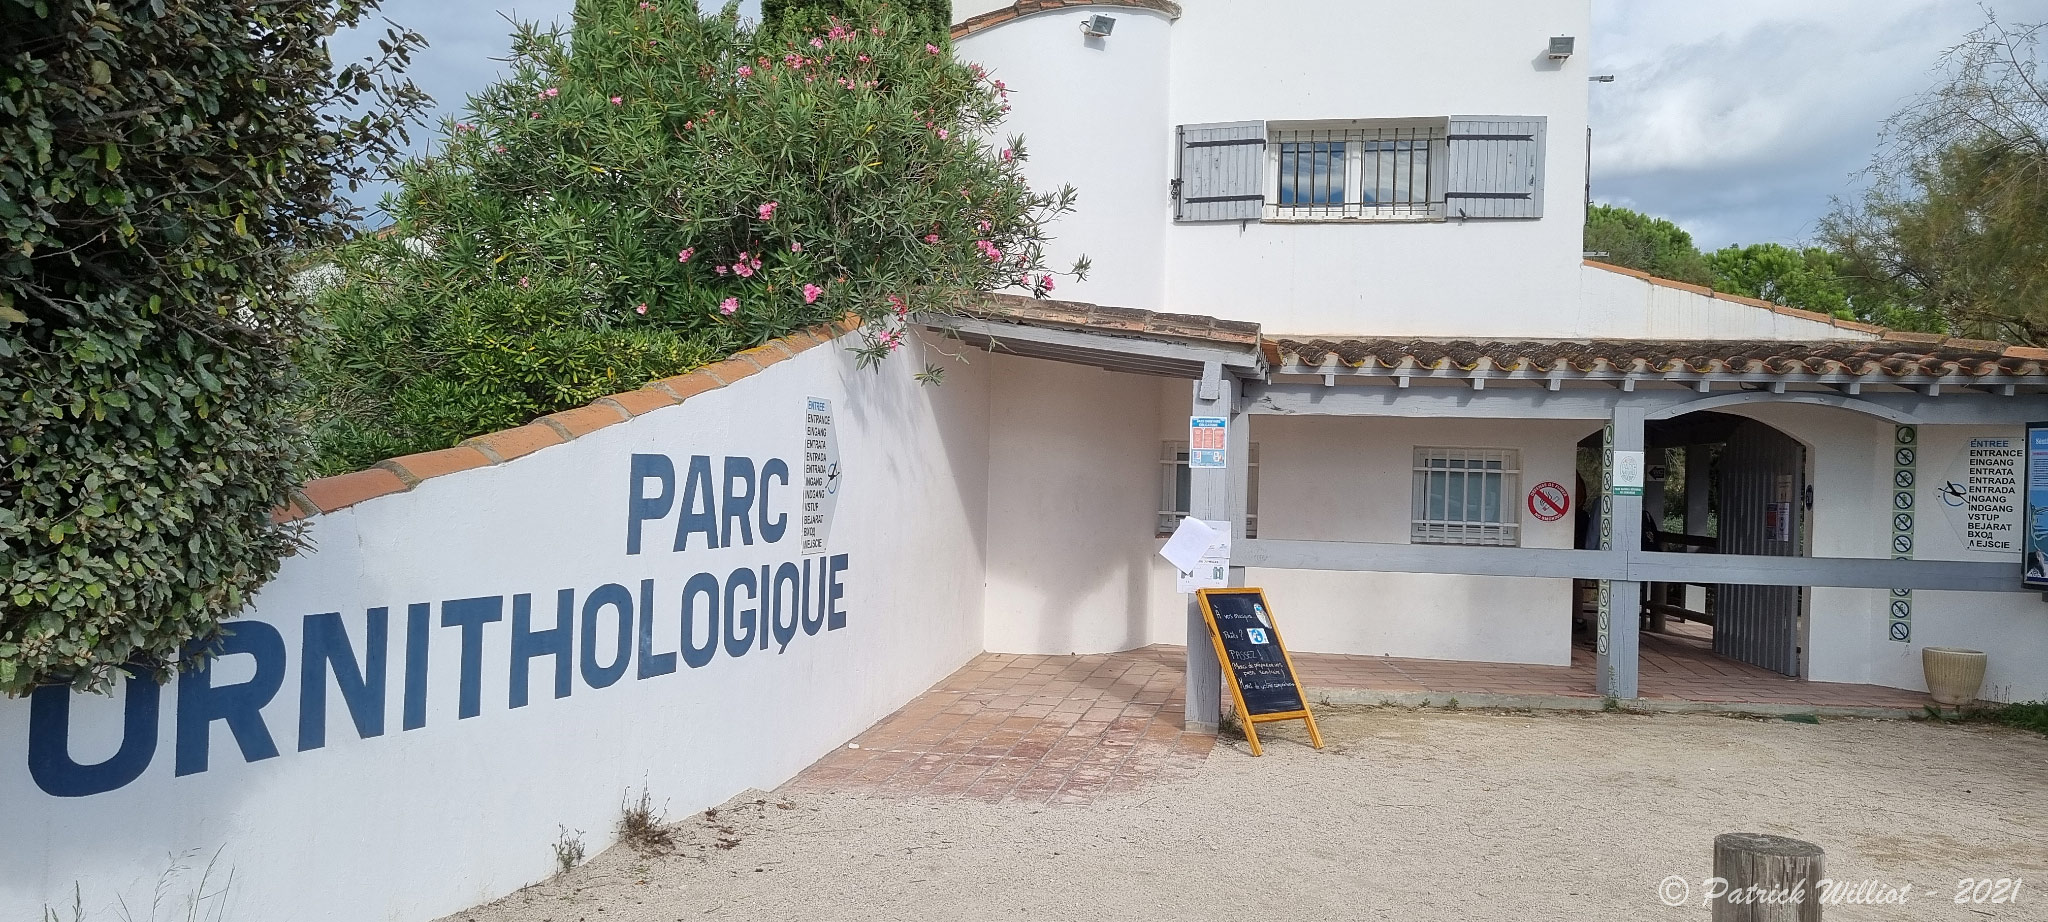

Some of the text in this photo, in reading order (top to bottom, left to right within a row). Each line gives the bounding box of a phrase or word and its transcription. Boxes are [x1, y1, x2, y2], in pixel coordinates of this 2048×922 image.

[807, 413, 831, 425] ENTRANCE
[807, 426, 827, 437] EINGANG
[806, 439, 826, 450] ENTRATA
[1970, 440, 2009, 448] ENTREE
[806, 452, 826, 462] ENTRADA
[1970, 449, 2023, 457] ENTRANCE
[1969, 458, 2014, 466] EINGANG
[806, 464, 826, 474] ENTRADA
[1969, 467, 2014, 476] ENTRATA
[805, 477, 822, 486] INGANG
[1969, 476, 2016, 485] ENTRADA
[804, 489, 825, 499] INDGANG
[1969, 486, 2015, 494] ENTRADA
[1968, 495, 2007, 503] INGANG
[626, 453, 789, 555] PARC
[1968, 504, 2014, 513] INDGANG
[1968, 513, 2000, 521] VSTUP
[1967, 530, 1993, 540] ВХОД
[28, 553, 849, 798] ORNITHOLOGIQUE
